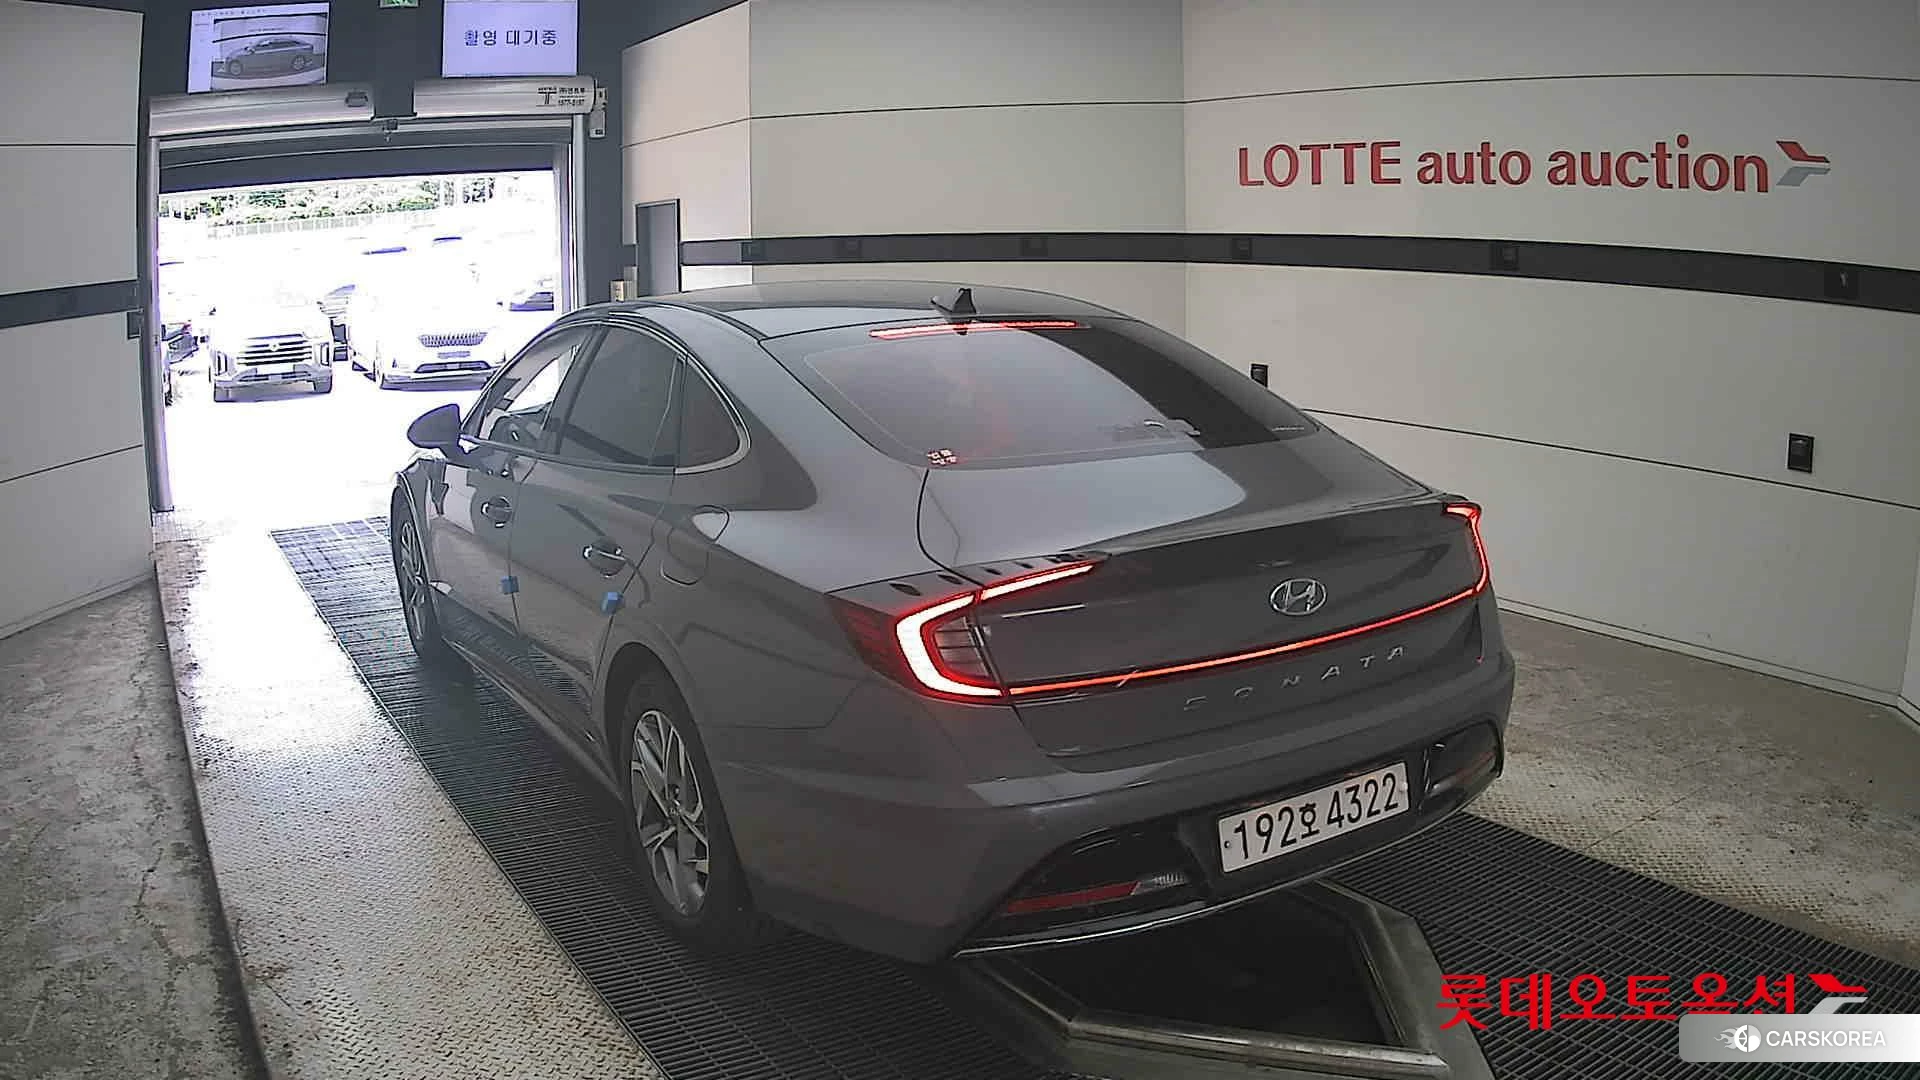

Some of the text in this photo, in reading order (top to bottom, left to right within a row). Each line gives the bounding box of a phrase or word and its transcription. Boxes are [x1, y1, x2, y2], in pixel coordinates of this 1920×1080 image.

[463, 29, 558, 47] 촬영 대기중
[1238, 134, 1769, 193] LOTTE auto auction
[1233, 772, 1400, 860] 192호 4322
